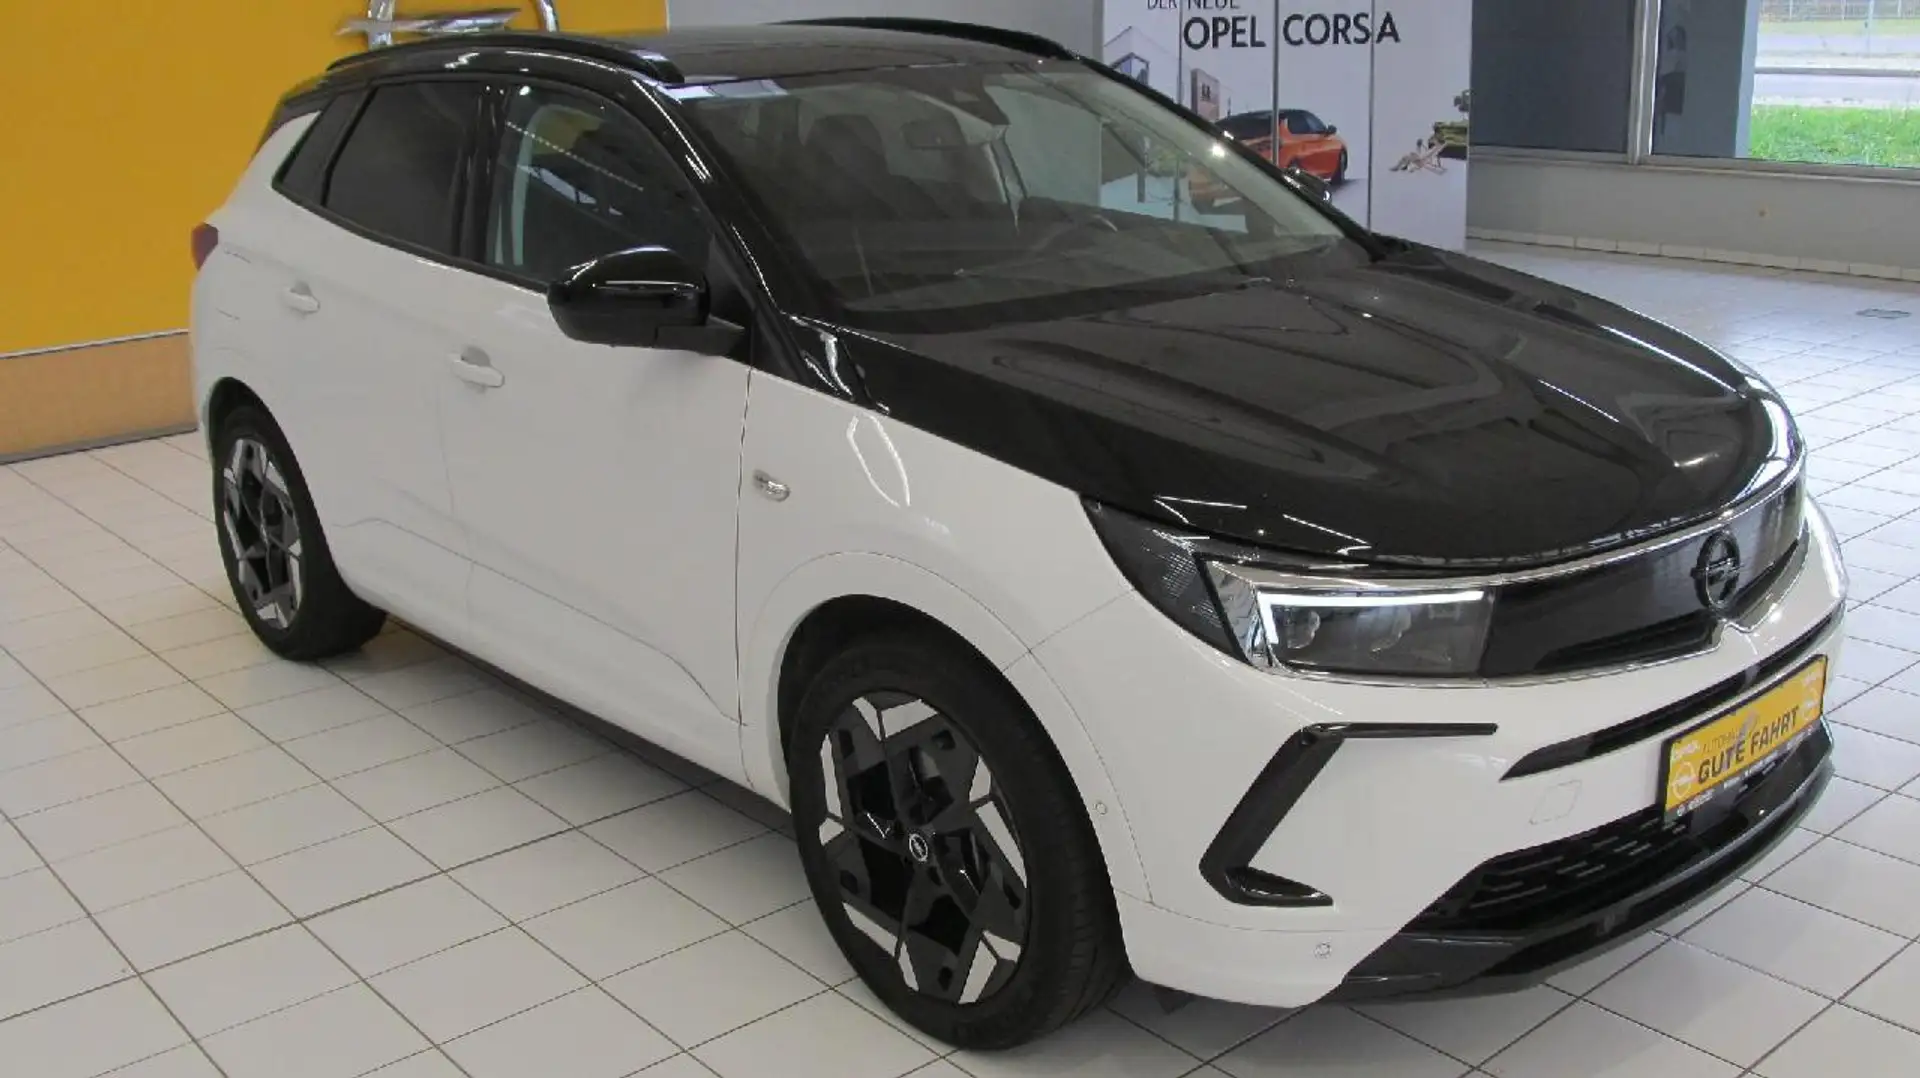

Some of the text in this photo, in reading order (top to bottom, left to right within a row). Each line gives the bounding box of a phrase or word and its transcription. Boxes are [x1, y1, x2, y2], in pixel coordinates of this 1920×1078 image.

[1183, 11, 1401, 50] OPEL CORSA
[1698, 738, 1745, 785] GUTE
[1750, 704, 1799, 756] FAHRT
